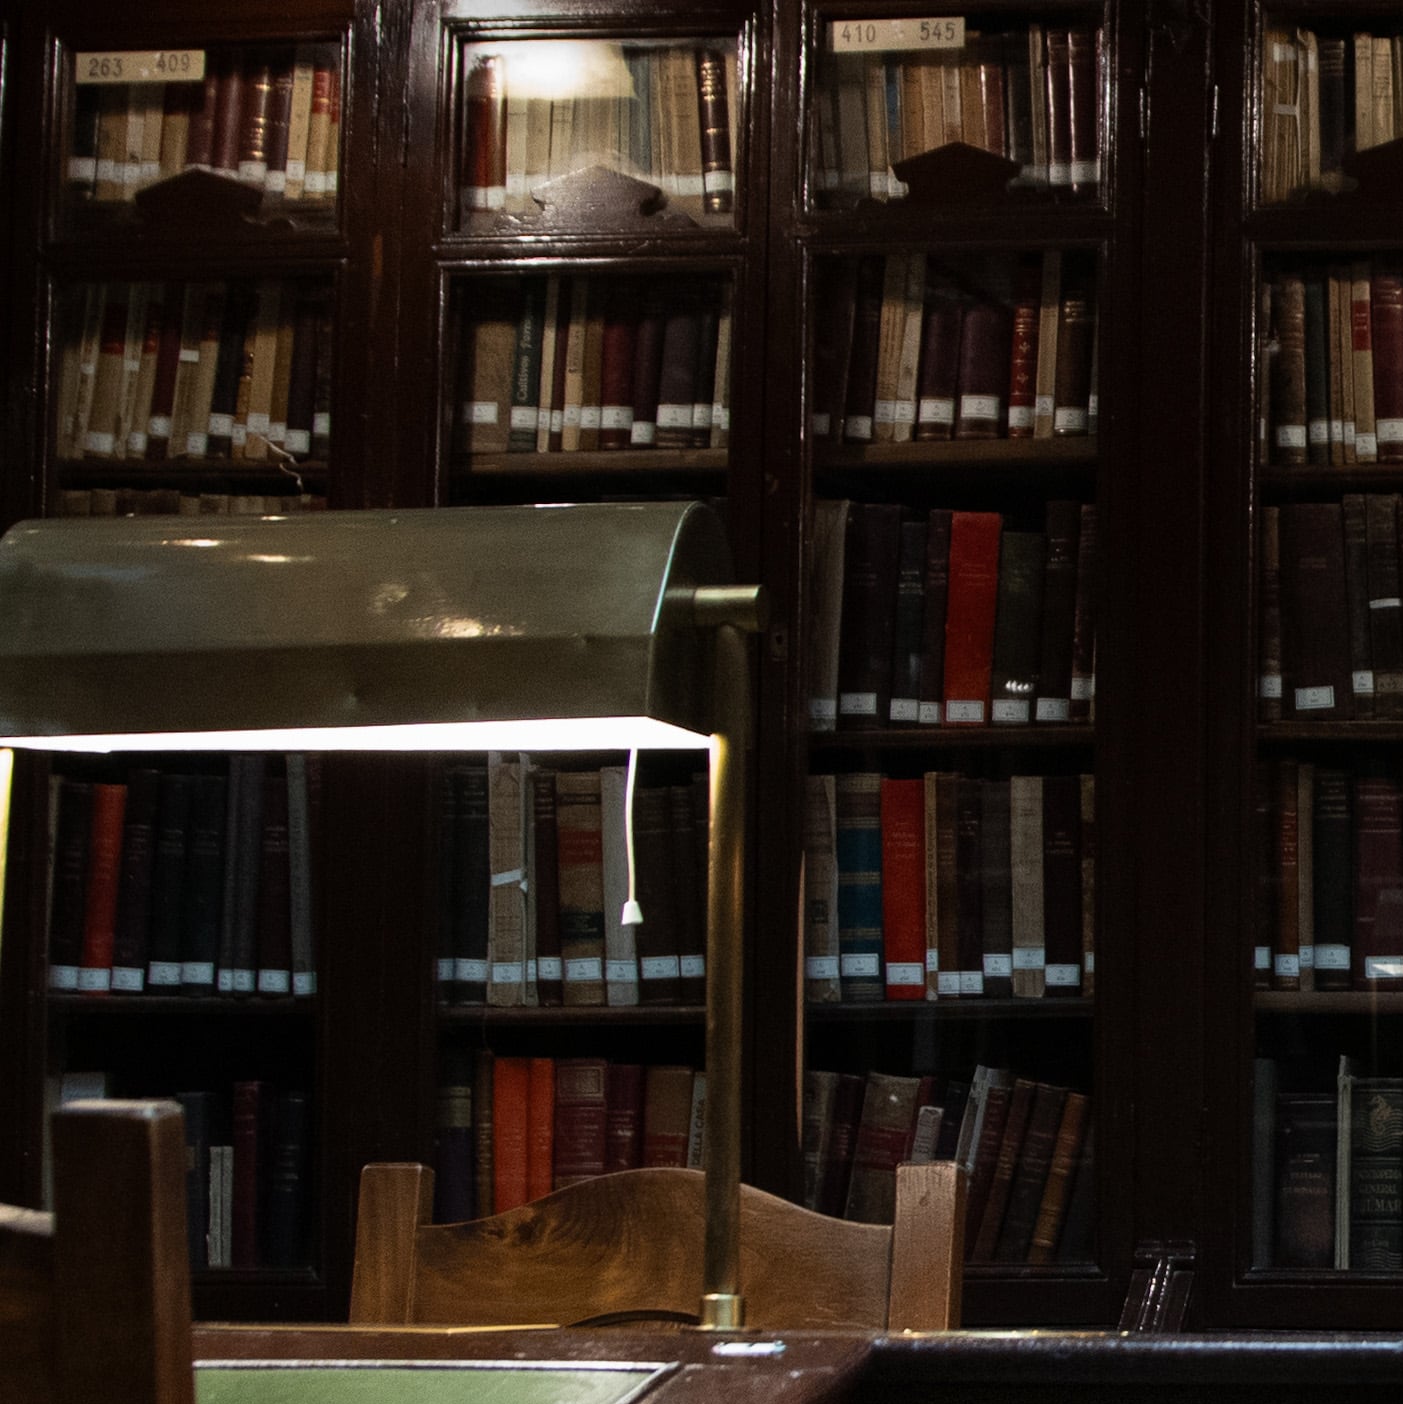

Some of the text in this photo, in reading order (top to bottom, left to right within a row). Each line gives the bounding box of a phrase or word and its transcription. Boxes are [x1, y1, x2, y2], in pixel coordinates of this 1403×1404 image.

[841, 22, 956, 43] 410 545
[88, 54, 191, 77] 263 409
